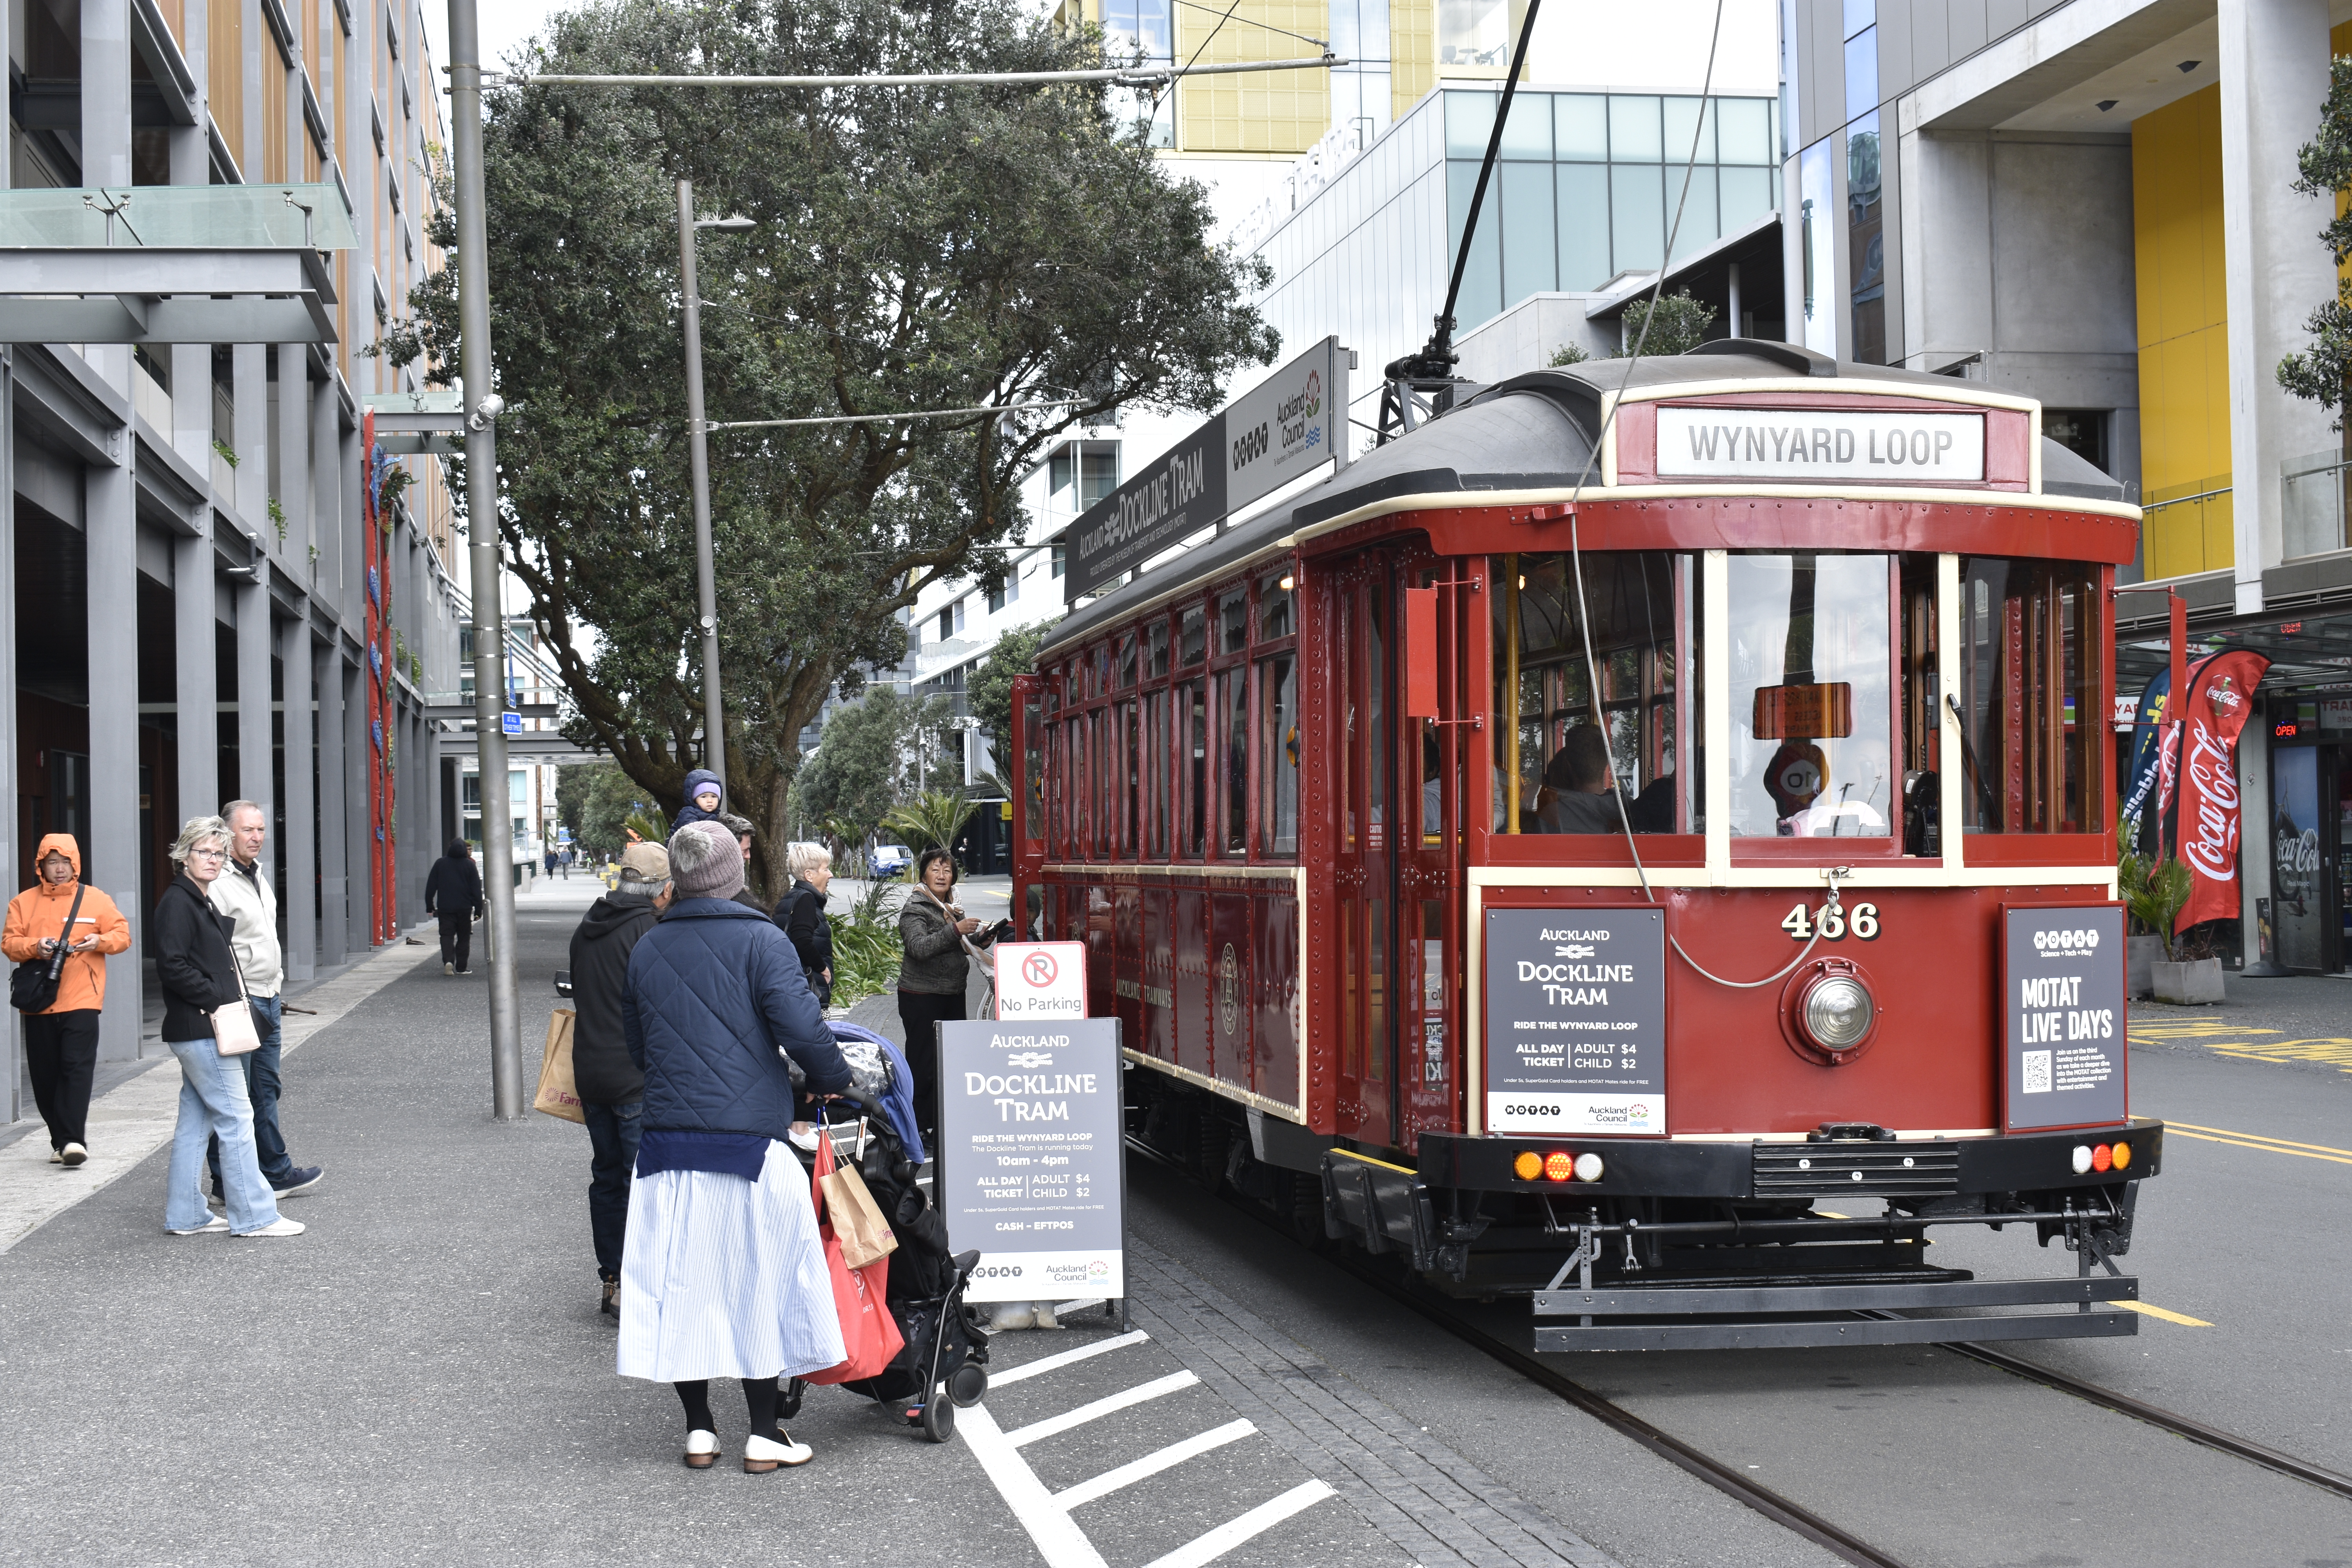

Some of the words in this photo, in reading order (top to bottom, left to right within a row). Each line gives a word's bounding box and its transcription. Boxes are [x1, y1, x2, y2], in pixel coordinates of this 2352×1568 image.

[1277, 387, 1305, 426] Auckland
[1282, 413, 1305, 448] Council
[1234, 426, 1267, 467] MOTAT
[1688, 425, 1855, 463] WYNYARD
[1869, 429, 1953, 465] LOOP
[1080, 525, 1103, 561] AUCKLAND
[1119, 471, 1168, 543] DOCKLINE
[1170, 447, 1203, 510] TRAM
[2207, 686, 2241, 707] Coca-Cola
[2276, 725, 2296, 735] OPEN
[2185, 717, 2241, 880] Coca-Cola
[1782, 903, 1879, 938] 466
[1540, 928, 1610, 940] AUCKLAND
[2035, 931, 2097, 947] MOTAT
[1517, 961, 1633, 982] DOCKLINE
[1116, 979, 1140, 1000] AUCKLAND
[1144, 985, 1172, 1009] TRAMWAYS
[1543, 984, 1608, 1005] TRAM
[2022, 977, 2081, 1008] MOTAT
[1001, 998, 1022, 1011] No
[1028, 997, 1082, 1012] Parking
[2023, 1012, 2062, 1043] LIVE
[2068, 1009, 2112, 1040] DAYS
[990, 1034, 1069, 1048] AUCKLAND
[1516, 1044, 1538, 1053] ALL
[1541, 1045, 1564, 1053] DAY
[1574, 1044, 1615, 1054] ADULT
[1621, 1044, 1637, 1054] $4
[1523, 1057, 1564, 1066] TICKET
[1575, 1058, 1612, 1068] CHILD
[1621, 1059, 1636, 1069] $2
[965, 1073, 1097, 1095] DOCKLINE
[994, 1098, 1069, 1122] TRAM
[1506, 1106, 1560, 1114] MOTAT
[1017, 1134, 1065, 1142] WYNYARD
[1045, 1144, 1071, 1152] running
[996, 1156, 1030, 1166] 10am
[1041, 1155, 1069, 1166] 4pm
[977, 1177, 998, 1186] ALL
[1001, 1176, 1023, 1185] DAY
[1032, 1174, 1070, 1184] ADULT
[1076, 1173, 1090, 1184] $4
[984, 1189, 1023, 1198] TICKET
[1033, 1188, 1067, 1198] CHILD
[1076, 1187, 1090, 1197] $2
[995, 1222, 1024, 1230] CASH
[1034, 1221, 1074, 1230] EFTPOS
[969, 1267, 1022, 1277] OTAT
[1046, 1265, 1086, 1273] Auckland
[1054, 1273, 1087, 1281] Council
